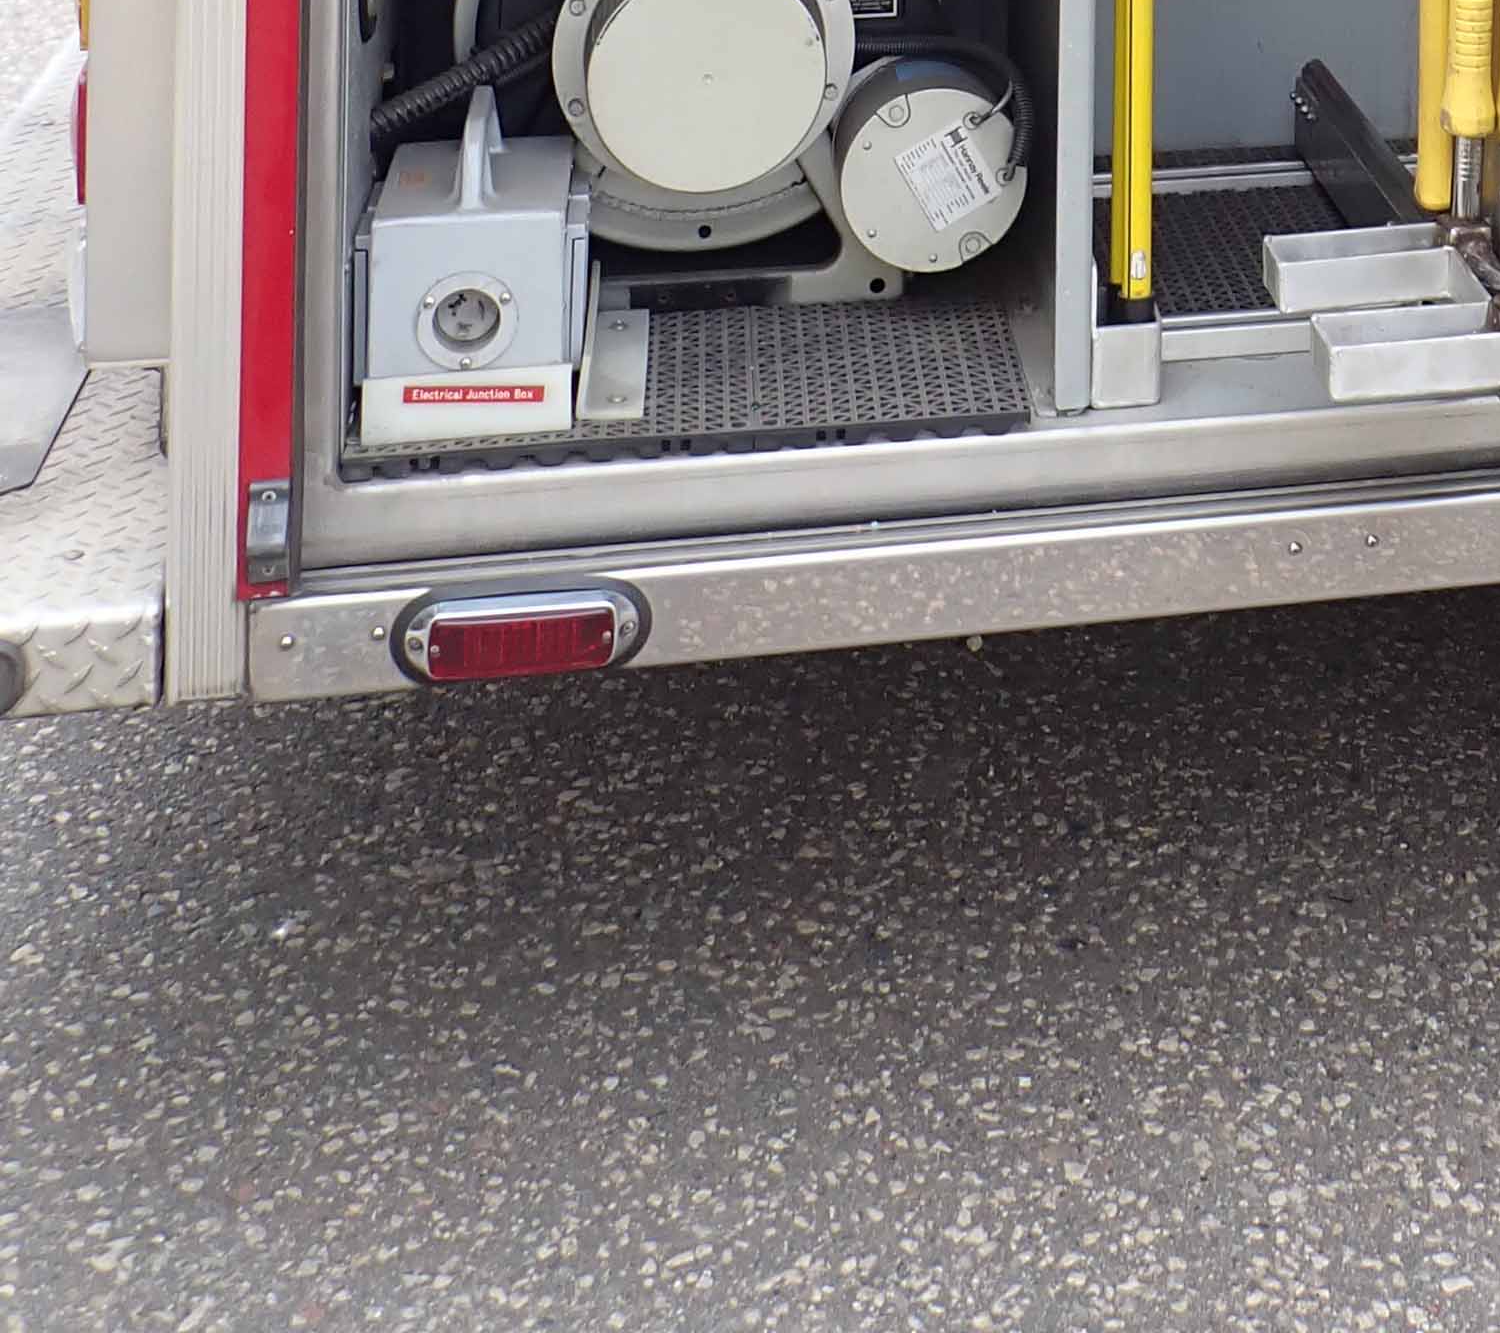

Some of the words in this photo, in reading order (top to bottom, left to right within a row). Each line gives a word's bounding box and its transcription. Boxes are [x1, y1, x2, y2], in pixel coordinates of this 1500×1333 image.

[412, 388, 463, 401] Electrical
[466, 389, 510, 401] Junction
[514, 388, 533, 400] Box
